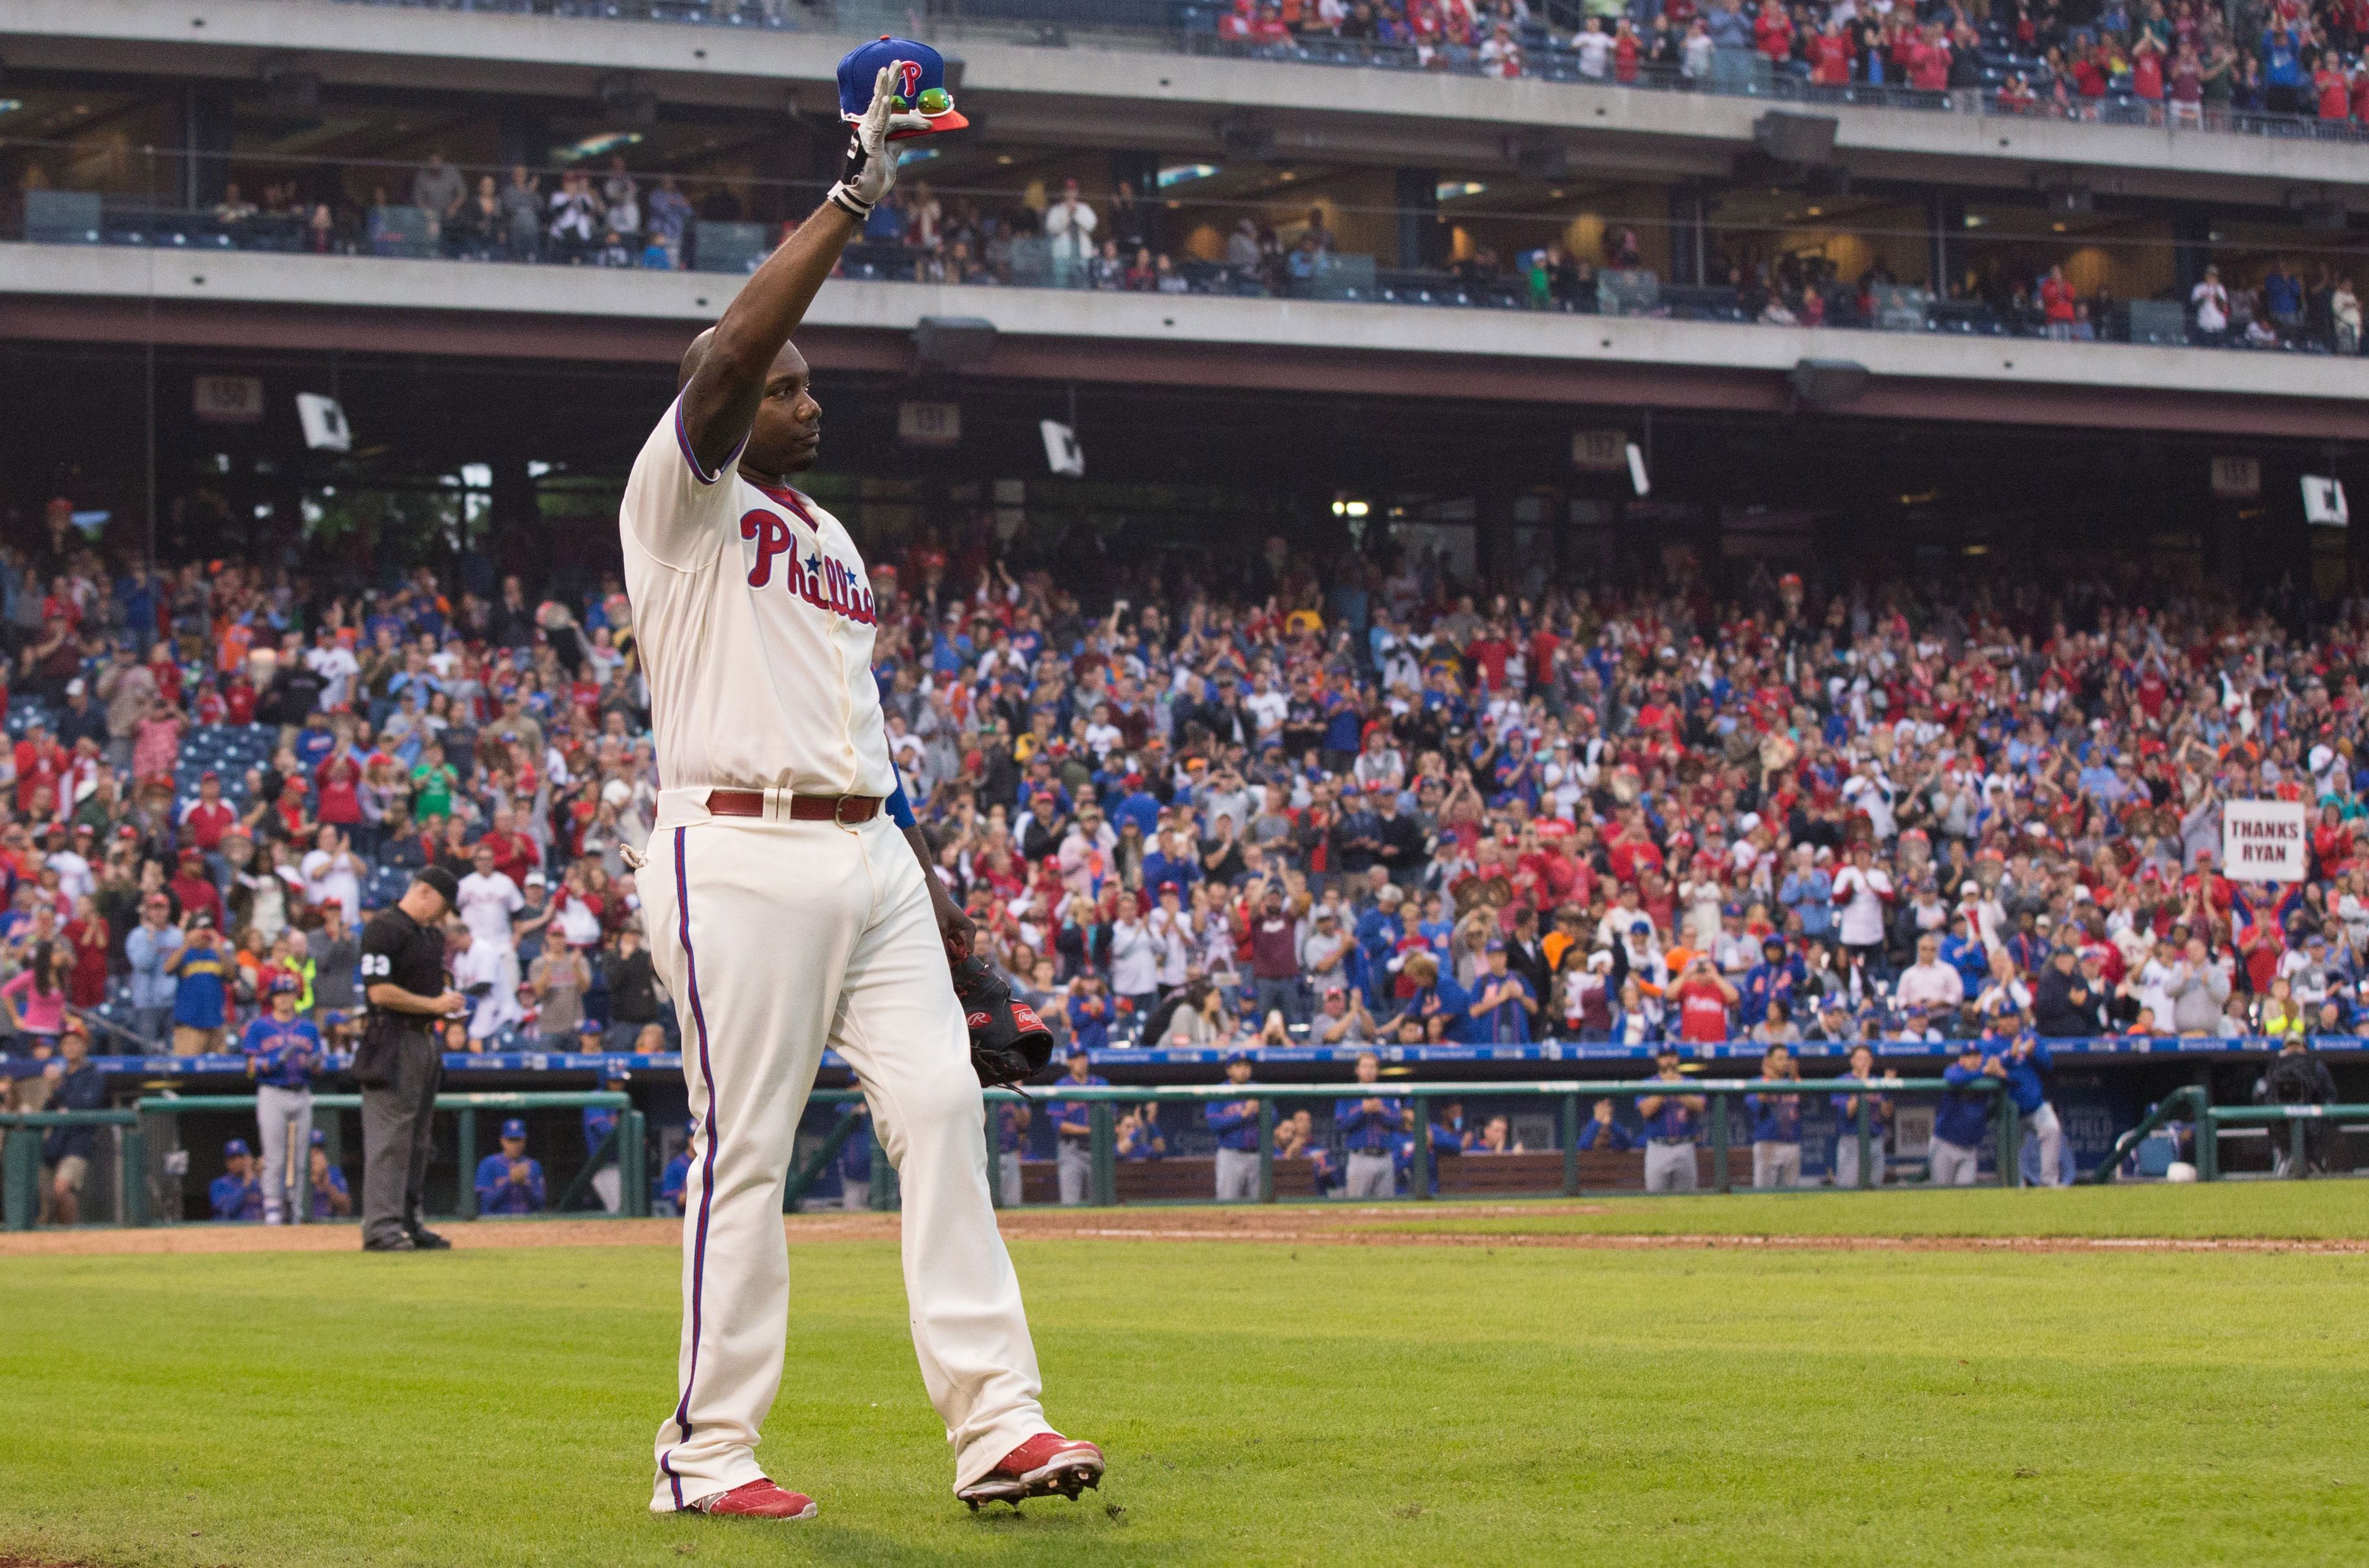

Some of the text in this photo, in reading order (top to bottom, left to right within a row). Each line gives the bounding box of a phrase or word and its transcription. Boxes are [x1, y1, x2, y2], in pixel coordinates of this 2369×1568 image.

[899, 61, 922, 97] P
[740, 509, 876, 627] Phillie
[2232, 820, 2298, 838] THANKS
[2242, 844, 2286, 862] RYAN
[361, 953, 391, 976] 23
[967, 1012, 989, 1025] R
